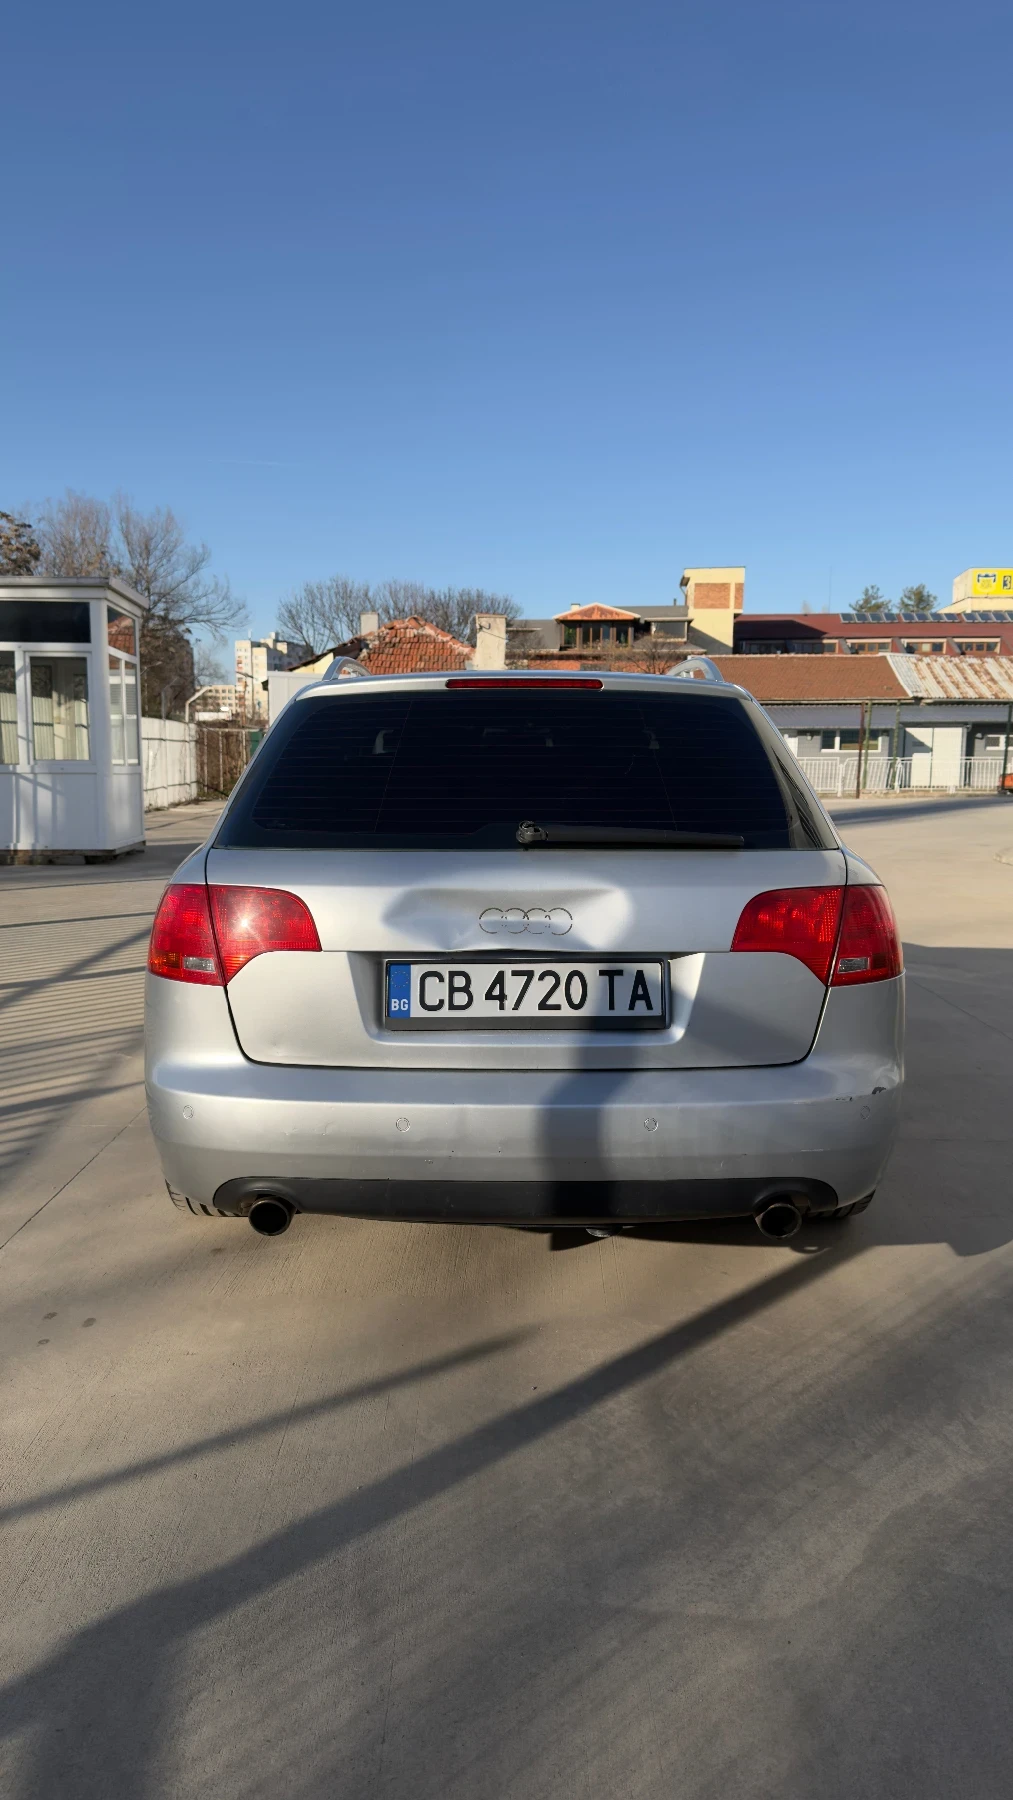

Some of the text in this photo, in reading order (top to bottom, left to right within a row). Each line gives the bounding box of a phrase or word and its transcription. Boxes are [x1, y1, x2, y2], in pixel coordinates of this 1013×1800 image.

[419, 969, 654, 1011] CB 4720 TA
[391, 998, 409, 1011] BG
